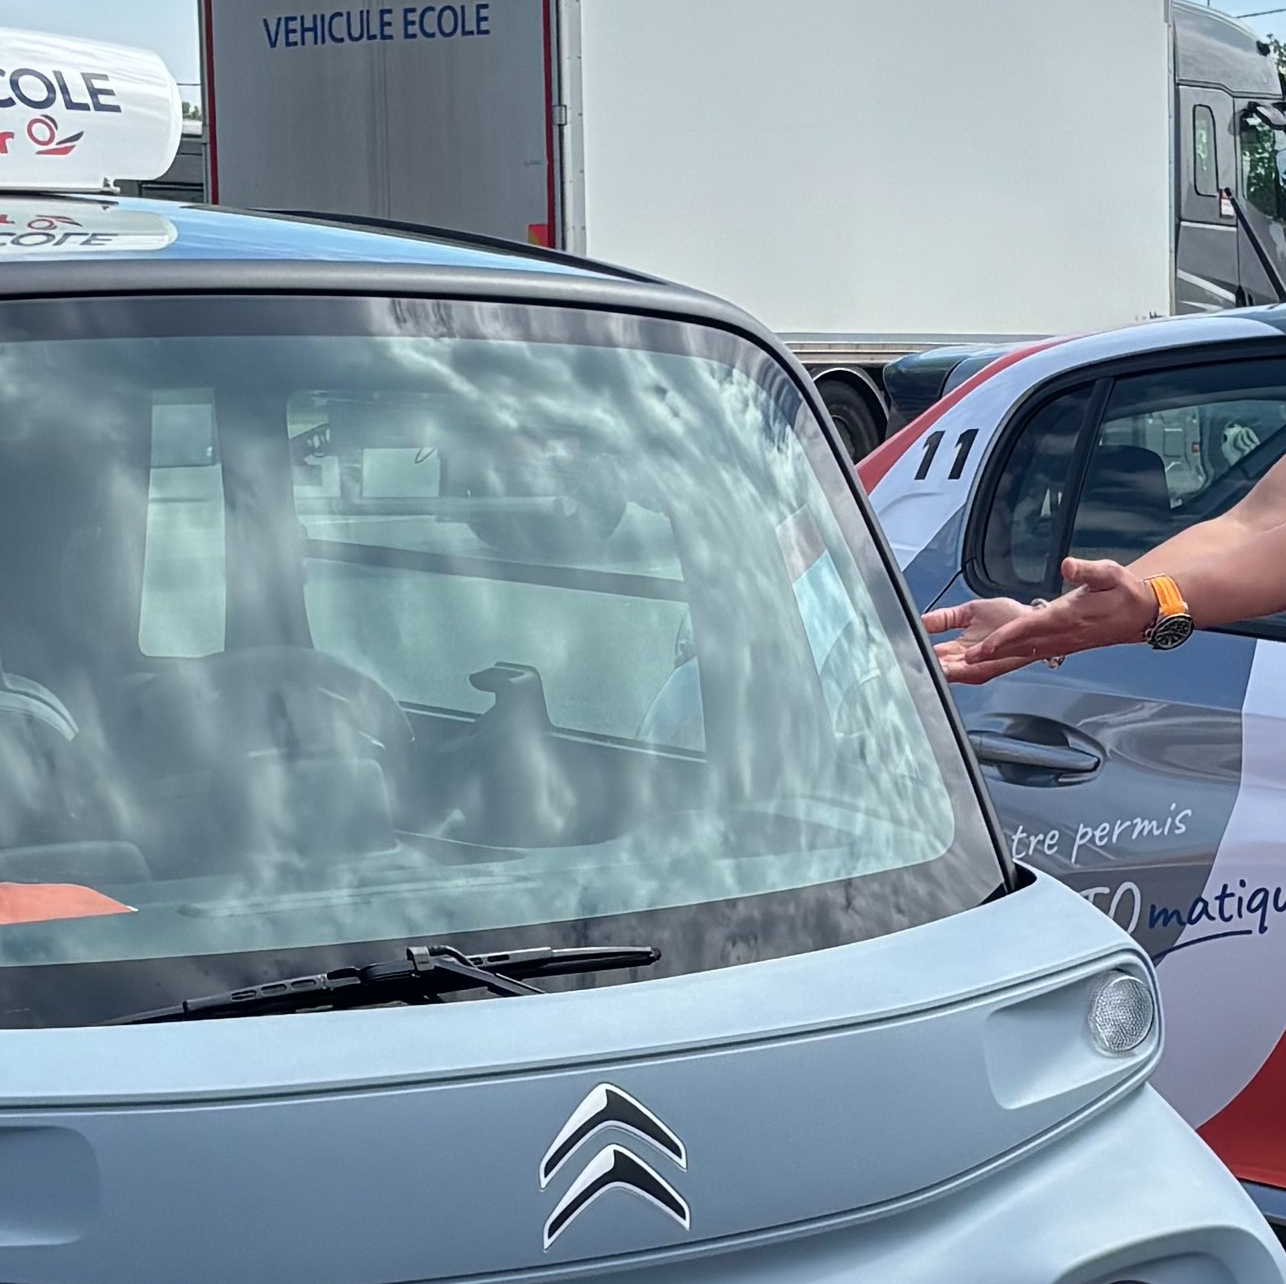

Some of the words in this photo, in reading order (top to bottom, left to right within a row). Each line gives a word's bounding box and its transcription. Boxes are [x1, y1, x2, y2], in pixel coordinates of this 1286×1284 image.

[263, 8, 394, 49] VEHICULE
[403, 3, 491, 39] ECOLE
[914, 429, 979, 480] 11
[1071, 802, 1192, 864] permis
